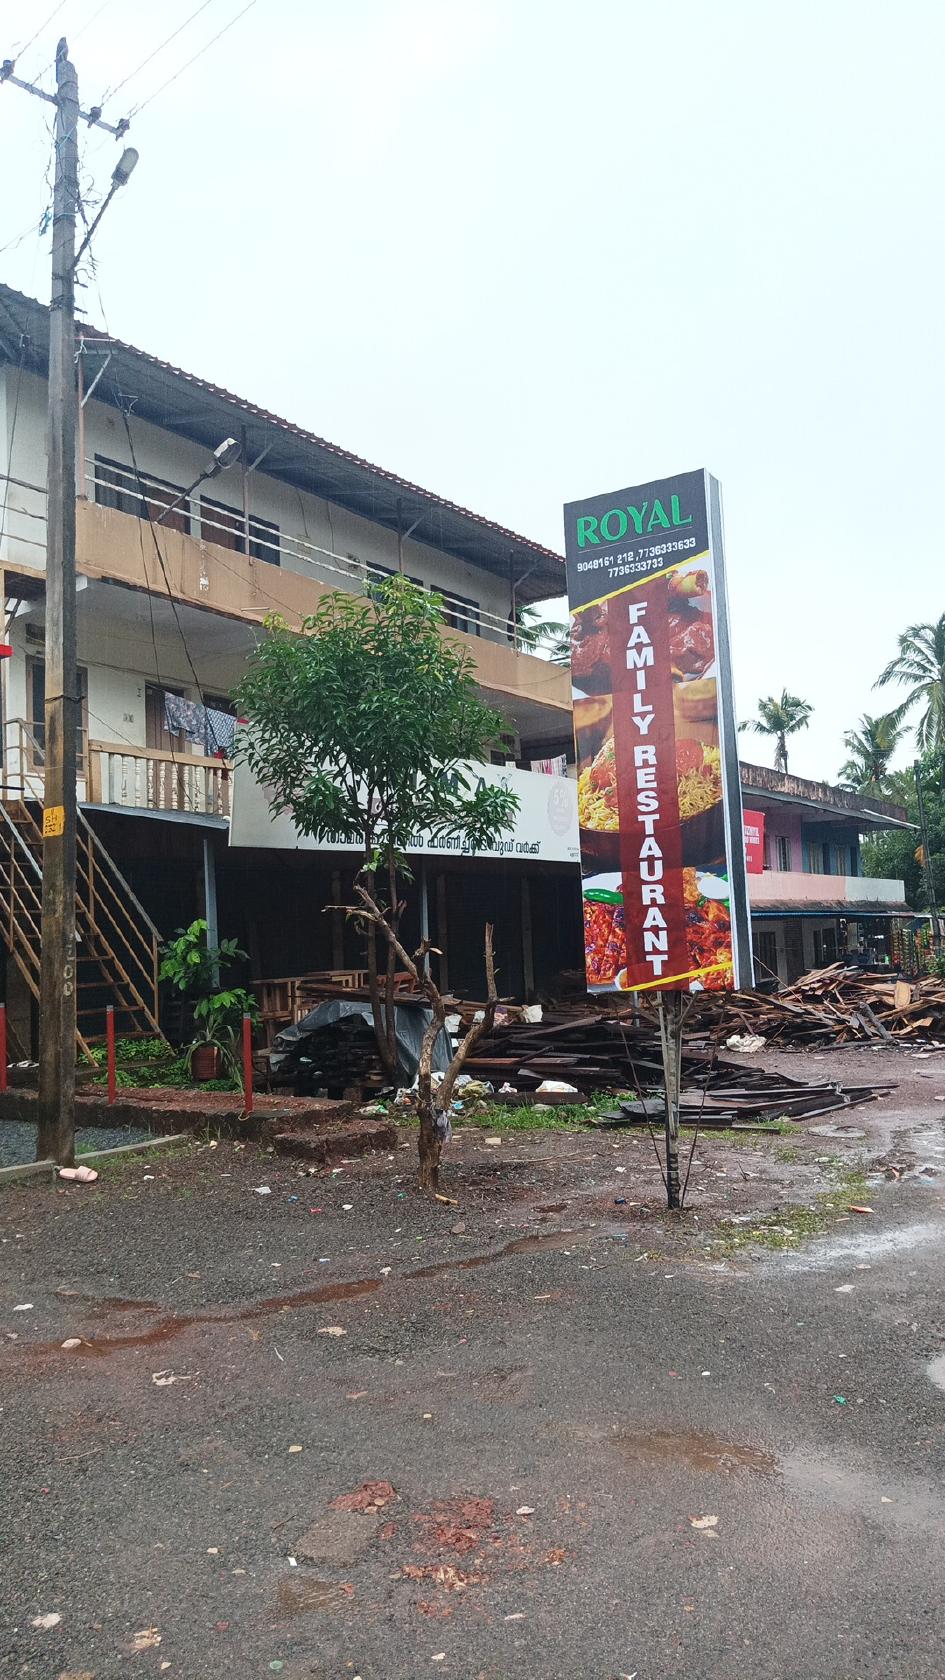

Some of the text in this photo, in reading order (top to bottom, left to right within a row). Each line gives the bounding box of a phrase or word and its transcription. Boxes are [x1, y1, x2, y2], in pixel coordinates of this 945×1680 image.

[576, 494, 693, 548] ROYAL
[577, 555, 614, 572] 9048161
[617, 552, 634, 564] 212
[608, 557, 664, 578] 7736333733
[626, 601, 655, 736] FAMILY
[633, 744, 669, 976] RESTAURANT
